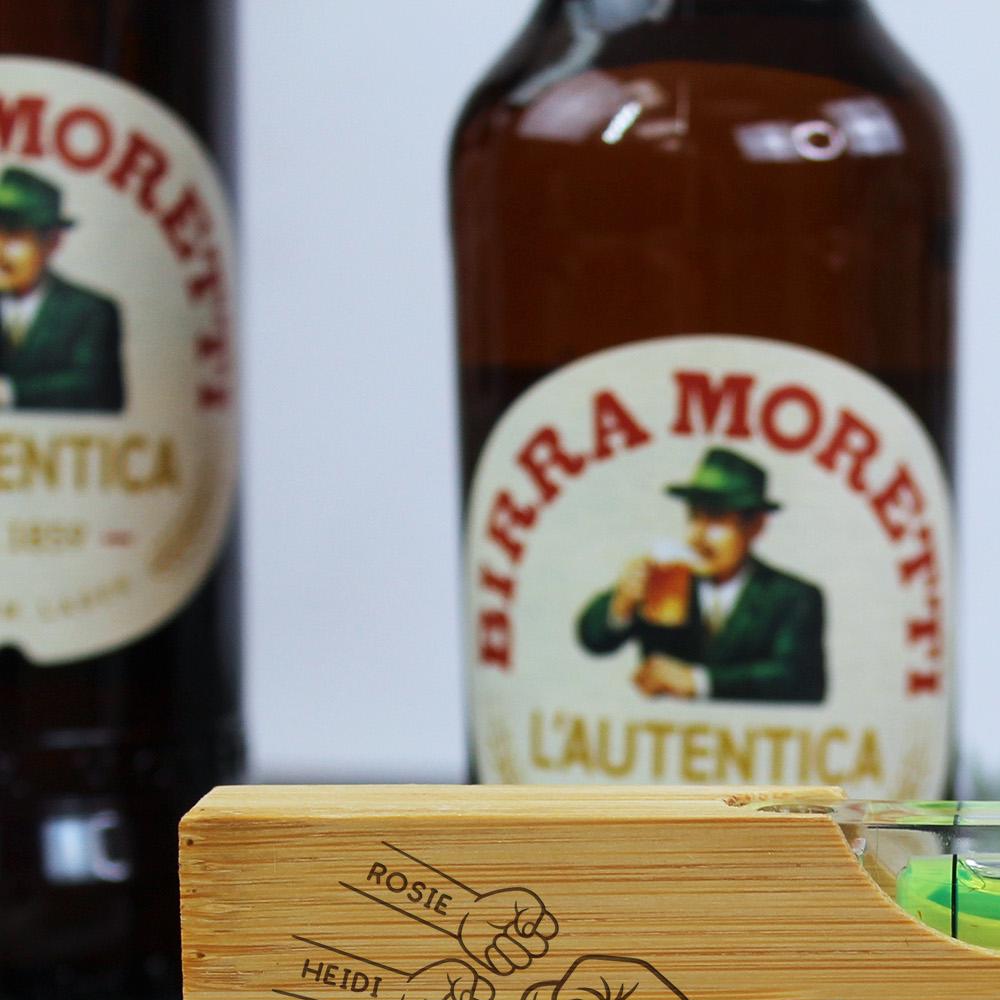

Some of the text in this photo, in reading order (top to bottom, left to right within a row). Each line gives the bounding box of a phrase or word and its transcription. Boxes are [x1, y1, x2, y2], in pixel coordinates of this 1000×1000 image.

[478, 369, 944, 696] BIRRA MORETTI
[529, 710, 885, 784] L'AUTENTICA
[366, 861, 453, 917] ROSIE
[300, 958, 382, 998] HEIDI
